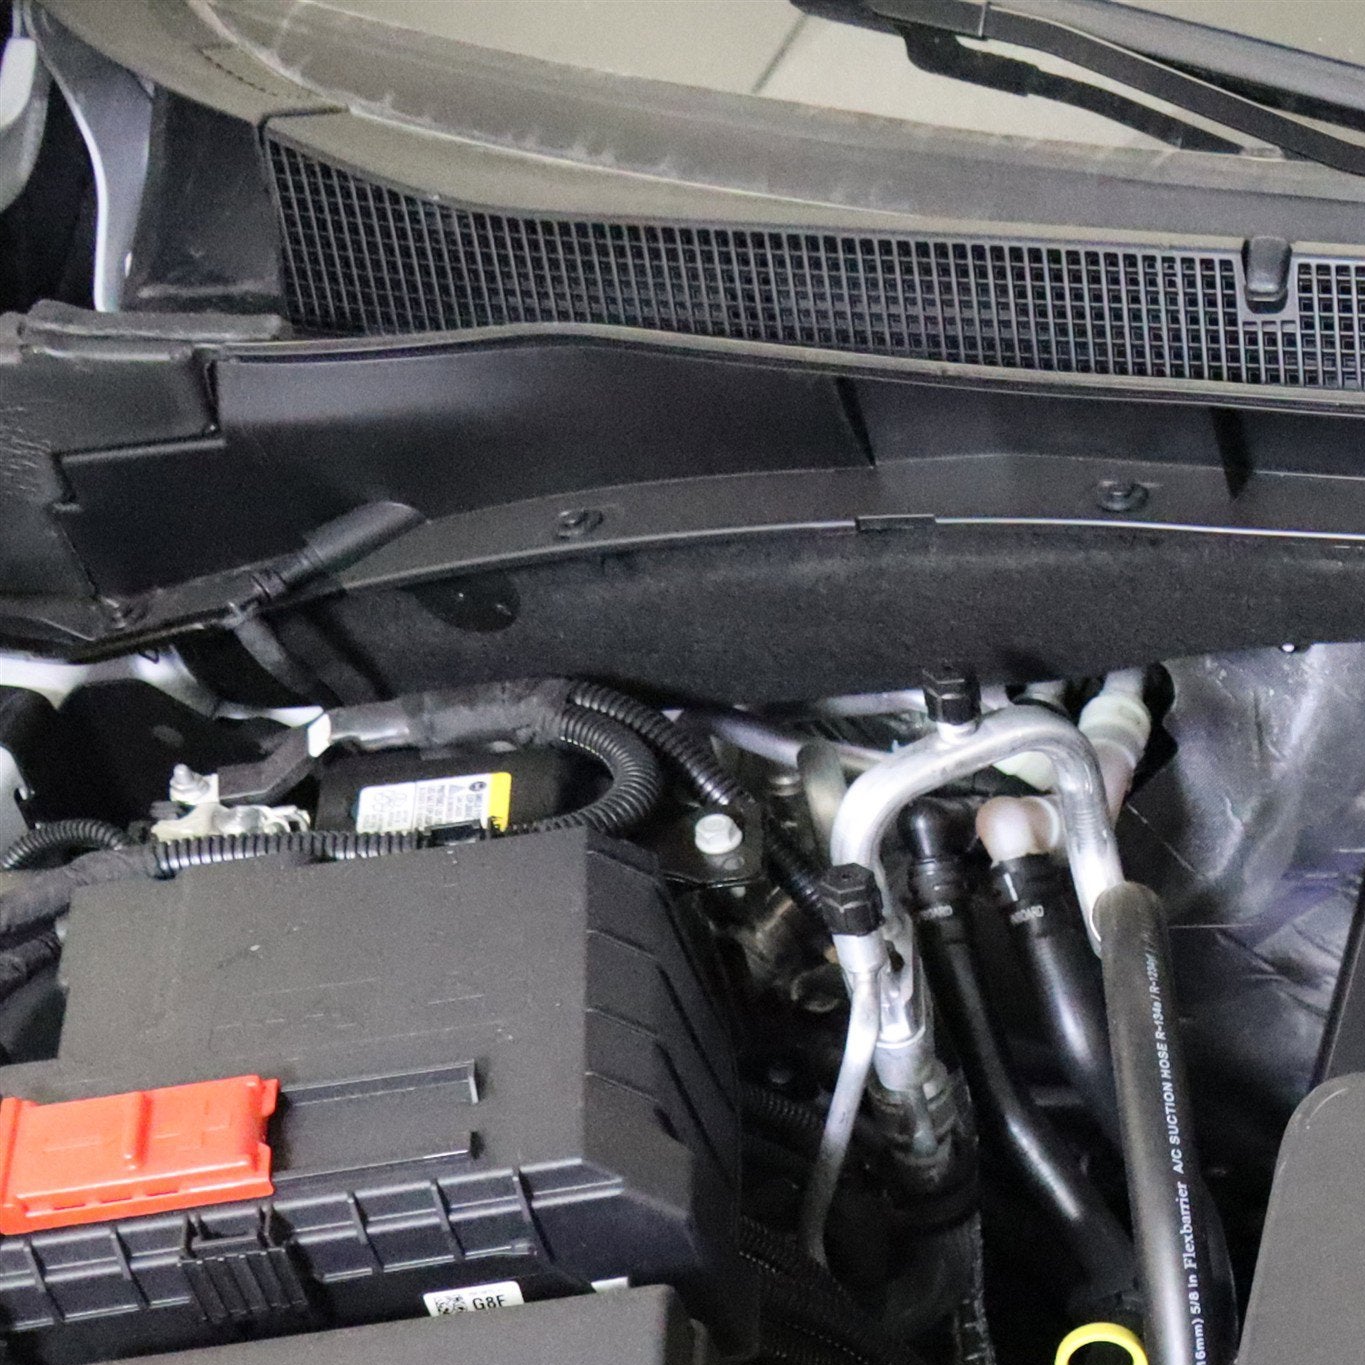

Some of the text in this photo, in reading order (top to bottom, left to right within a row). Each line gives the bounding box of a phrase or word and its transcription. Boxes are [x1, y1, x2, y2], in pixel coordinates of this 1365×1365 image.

[1156, 1042, 1172, 1079] HOSE
[1162, 1082, 1181, 1145] SUCTION
[1170, 1149, 1184, 1174] A/C
[1174, 1181, 1198, 1269] Flexbarrier
[1188, 1291, 1201, 1314] 5/8
